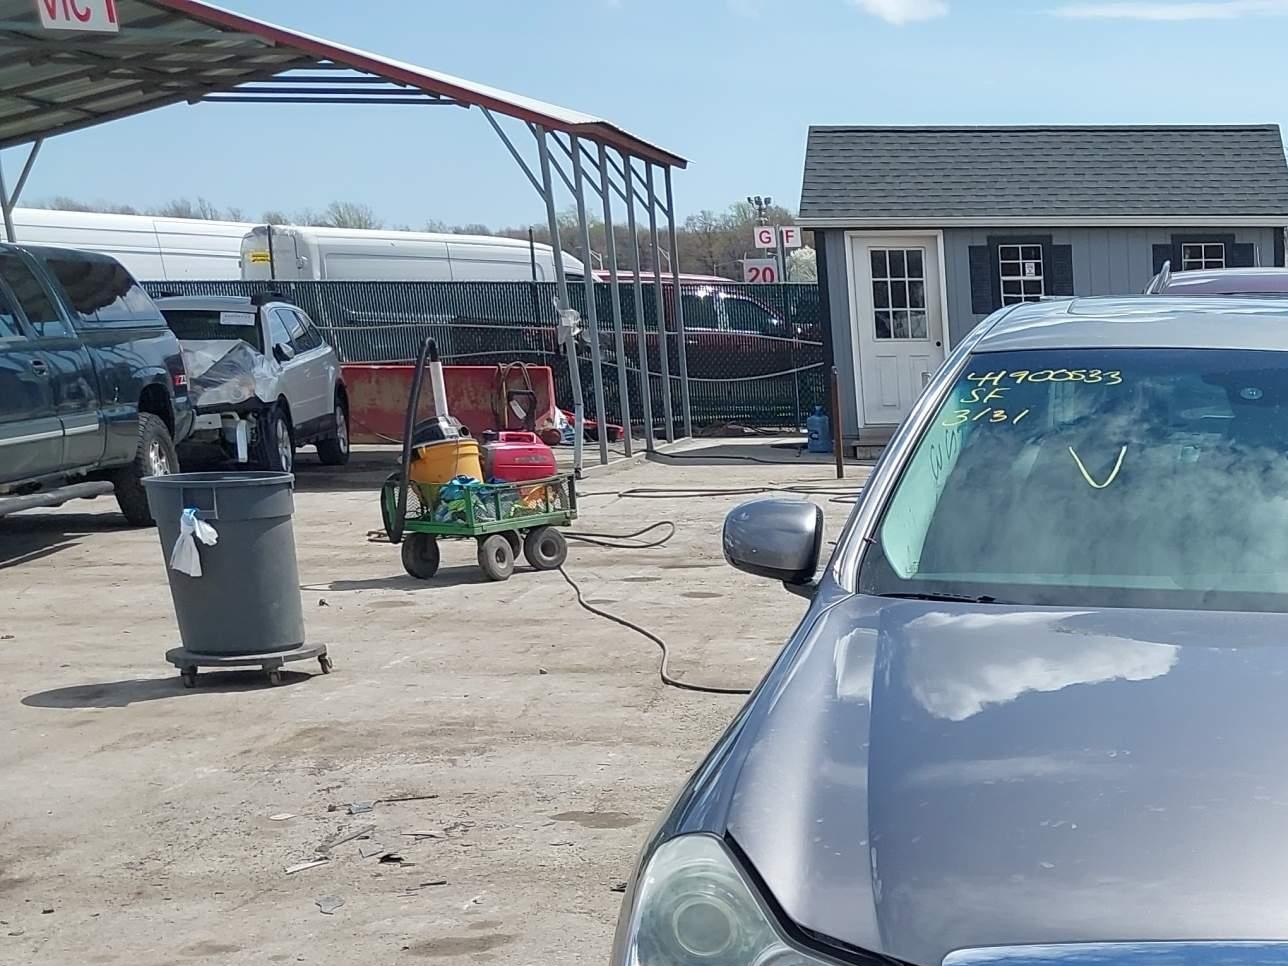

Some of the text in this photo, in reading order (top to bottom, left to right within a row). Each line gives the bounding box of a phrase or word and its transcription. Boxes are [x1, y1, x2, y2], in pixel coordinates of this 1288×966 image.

[758, 230, 772, 244] G
[785, 230, 795, 243] F
[748, 267, 775, 283] 20
[960, 387, 1010, 404] SF
